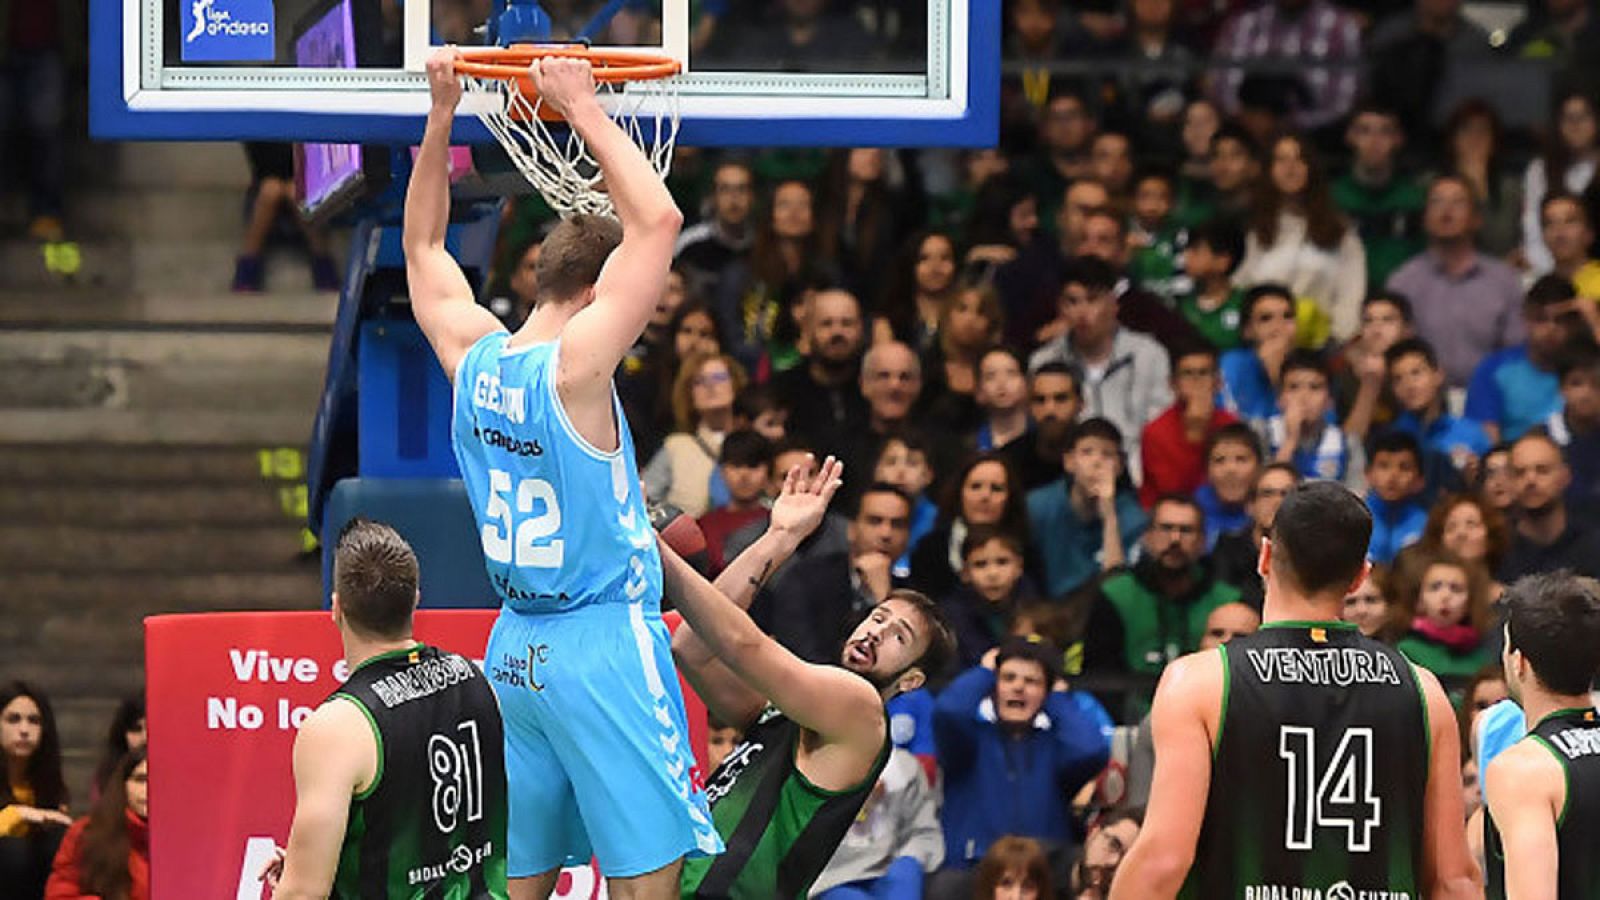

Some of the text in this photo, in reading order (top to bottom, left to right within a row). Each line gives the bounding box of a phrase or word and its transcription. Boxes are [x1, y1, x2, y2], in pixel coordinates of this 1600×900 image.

[482, 468, 564, 568] 52
[229, 649, 319, 682] Vive
[1247, 648, 1400, 686] VENTURA
[207, 697, 263, 729] No
[428, 720, 482, 833] 81
[1280, 725, 1380, 852] 14
